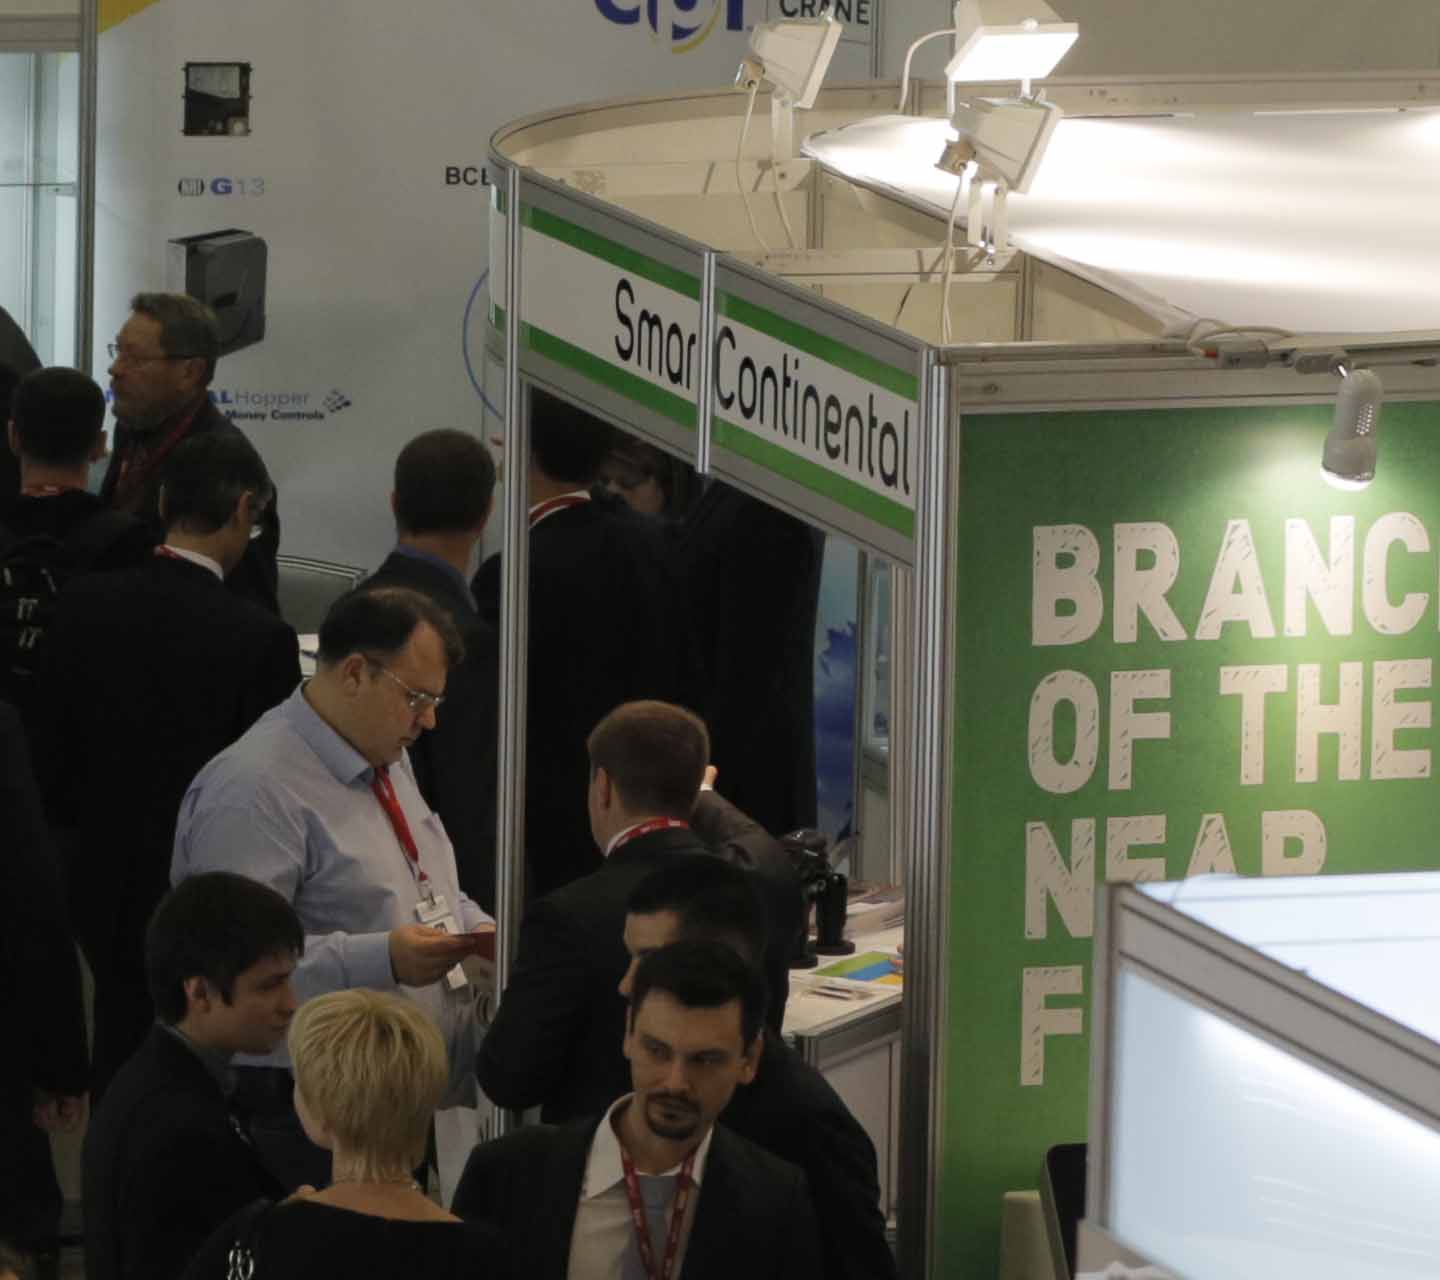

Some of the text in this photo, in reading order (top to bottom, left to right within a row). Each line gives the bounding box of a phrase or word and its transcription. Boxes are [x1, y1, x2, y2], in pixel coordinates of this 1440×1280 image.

[614, 277, 911, 498] Smar Continental
[1027, 658, 1434, 794] OF THE
[1019, 966, 1085, 1087] F
